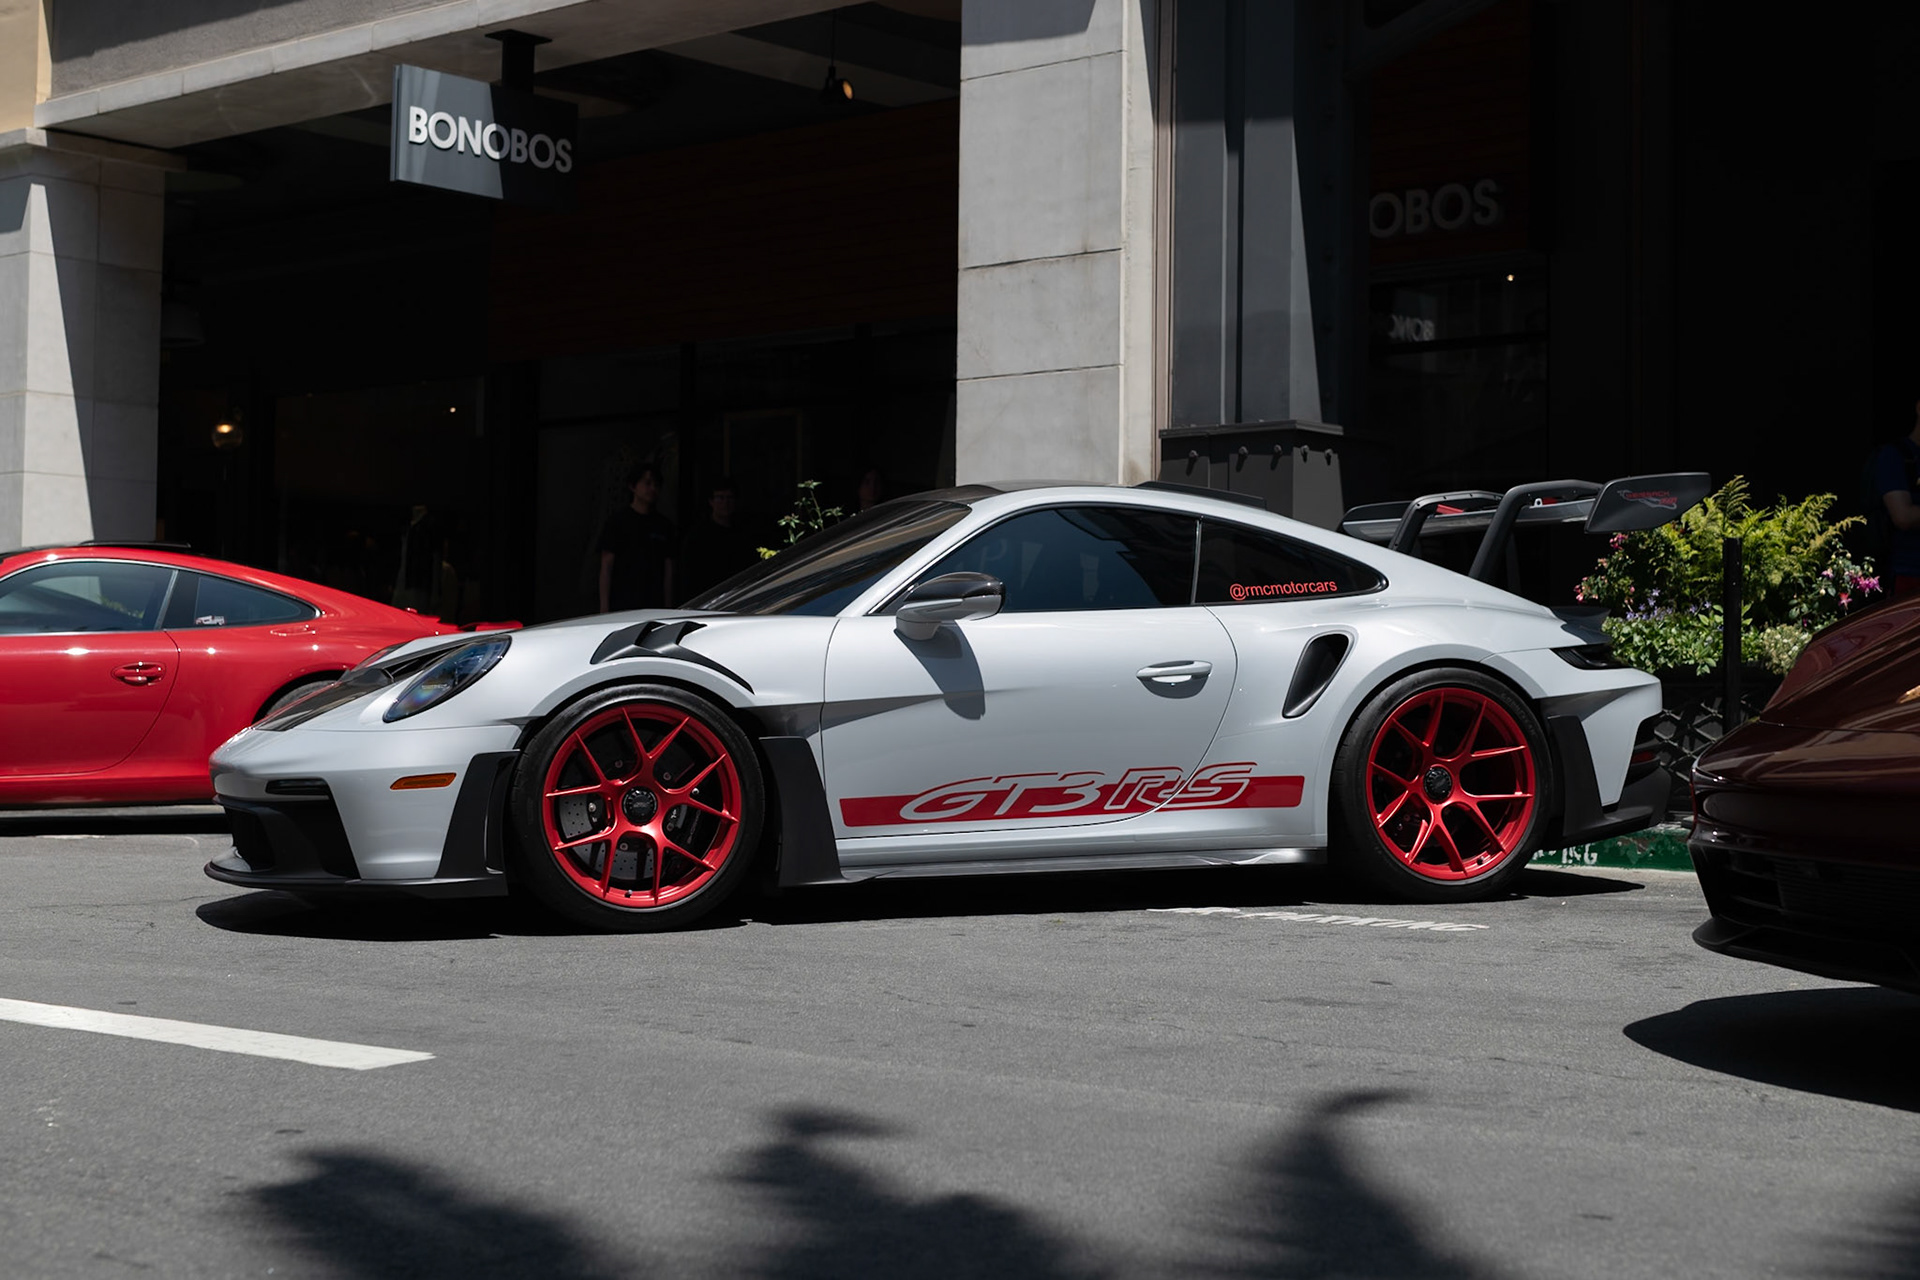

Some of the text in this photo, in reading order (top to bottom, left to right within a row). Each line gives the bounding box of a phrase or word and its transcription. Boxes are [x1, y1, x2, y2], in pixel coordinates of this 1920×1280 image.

[409, 105, 572, 173] BONOBOS
[1369, 178, 1500, 238] OBOS
[1229, 580, 1338, 601] @rmcmotorcars
